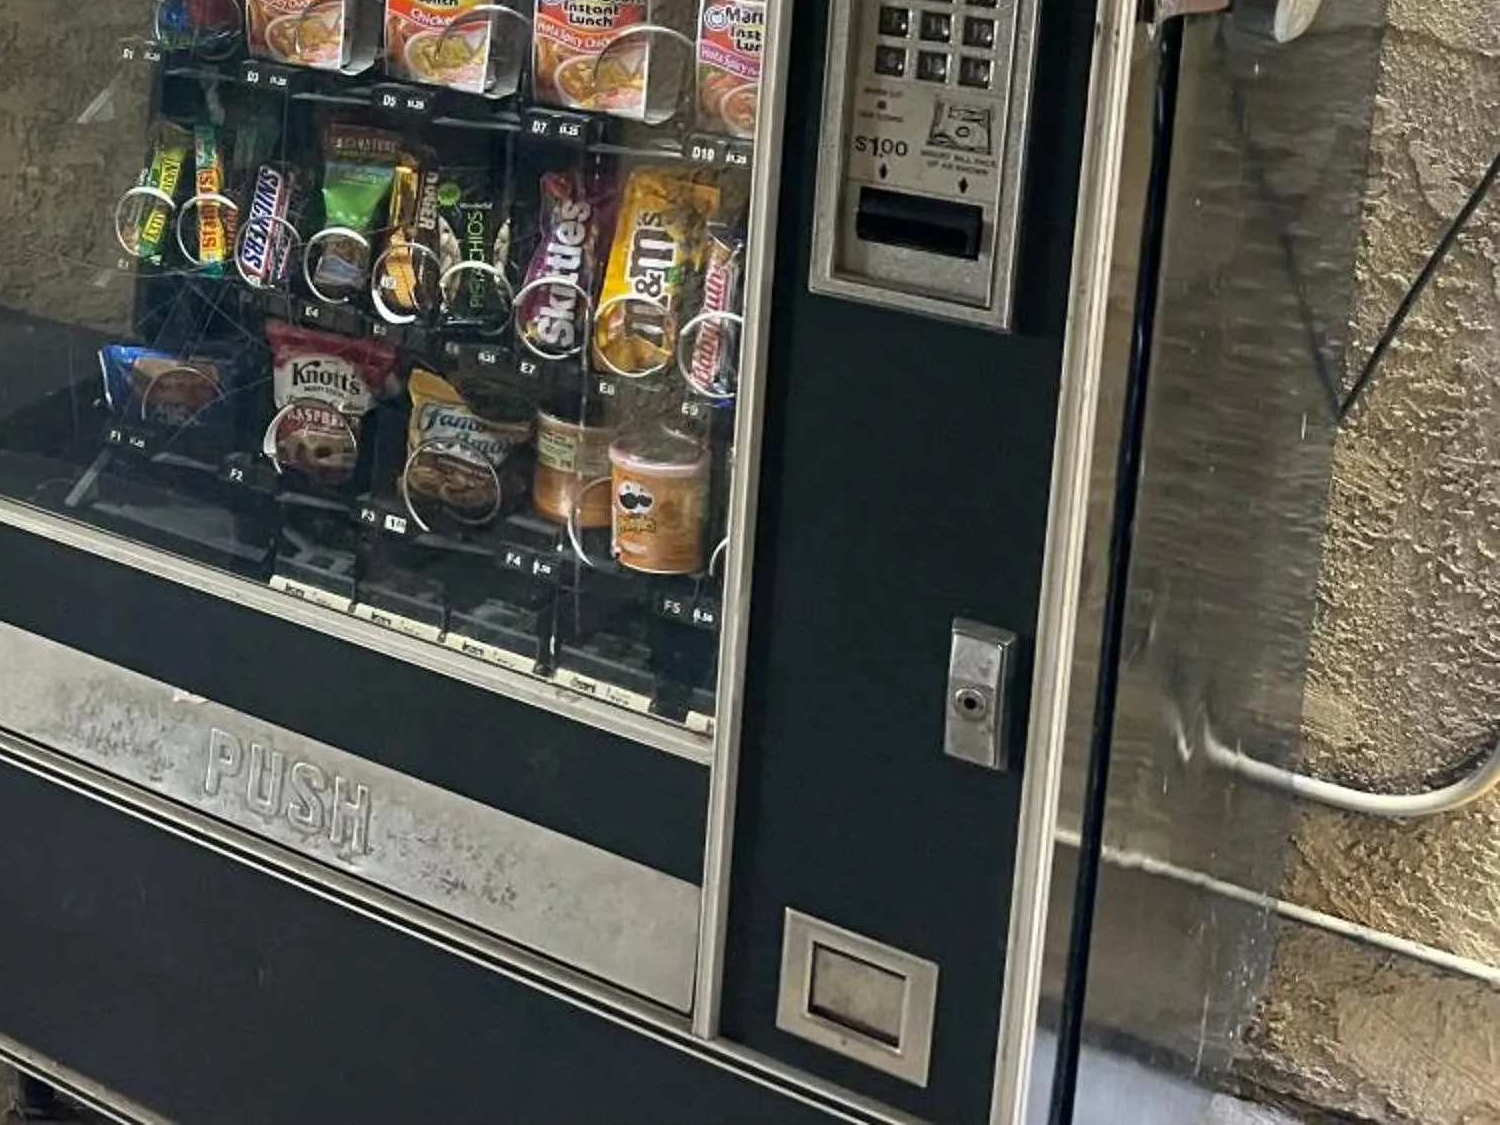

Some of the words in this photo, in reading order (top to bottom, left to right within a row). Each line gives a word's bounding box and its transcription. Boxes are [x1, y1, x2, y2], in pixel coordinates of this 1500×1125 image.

[563, 0, 620, 16] Instant
[569, 13, 613, 27] Lunch
[730, 26, 762, 42] Inst
[383, 94, 396, 107] D5
[532, 120, 548, 135] D7
[855, 135, 908, 158] $1.00
[240, 165, 280, 271] SNICKERS
[536, 200, 592, 350] Skittles
[291, 360, 361, 396] Knott's
[203, 726, 372, 856] PUSH
